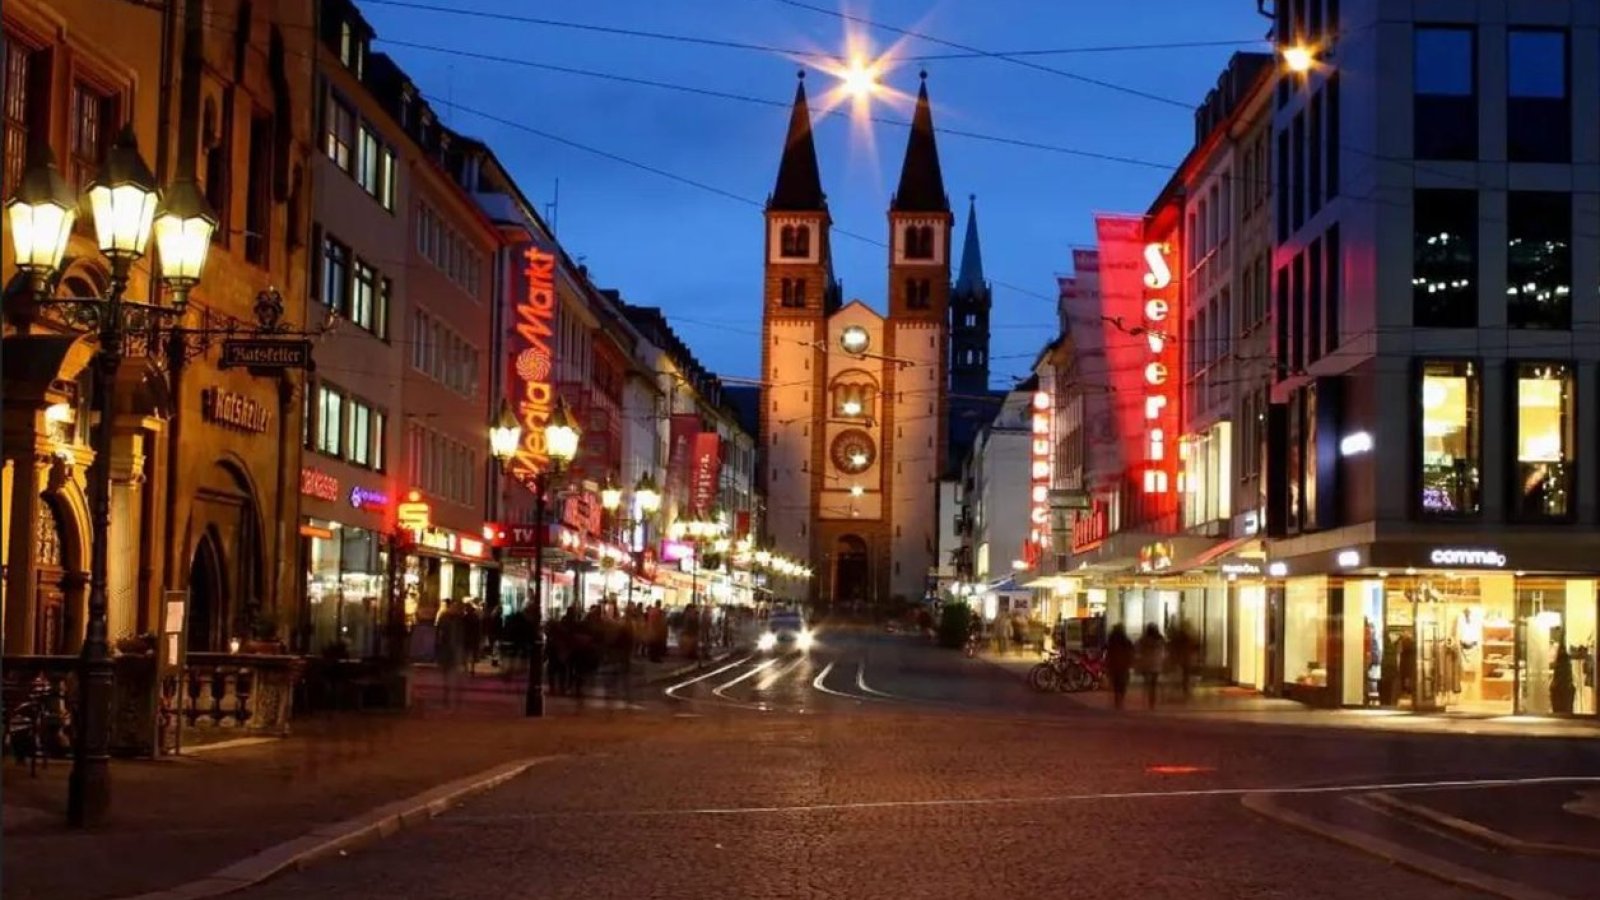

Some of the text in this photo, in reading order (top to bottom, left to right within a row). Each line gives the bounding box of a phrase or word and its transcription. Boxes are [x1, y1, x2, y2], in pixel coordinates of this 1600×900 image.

[513, 247, 554, 483] Media Markt
[1143, 242, 1172, 493] Severin
[513, 528, 533, 542] TV
